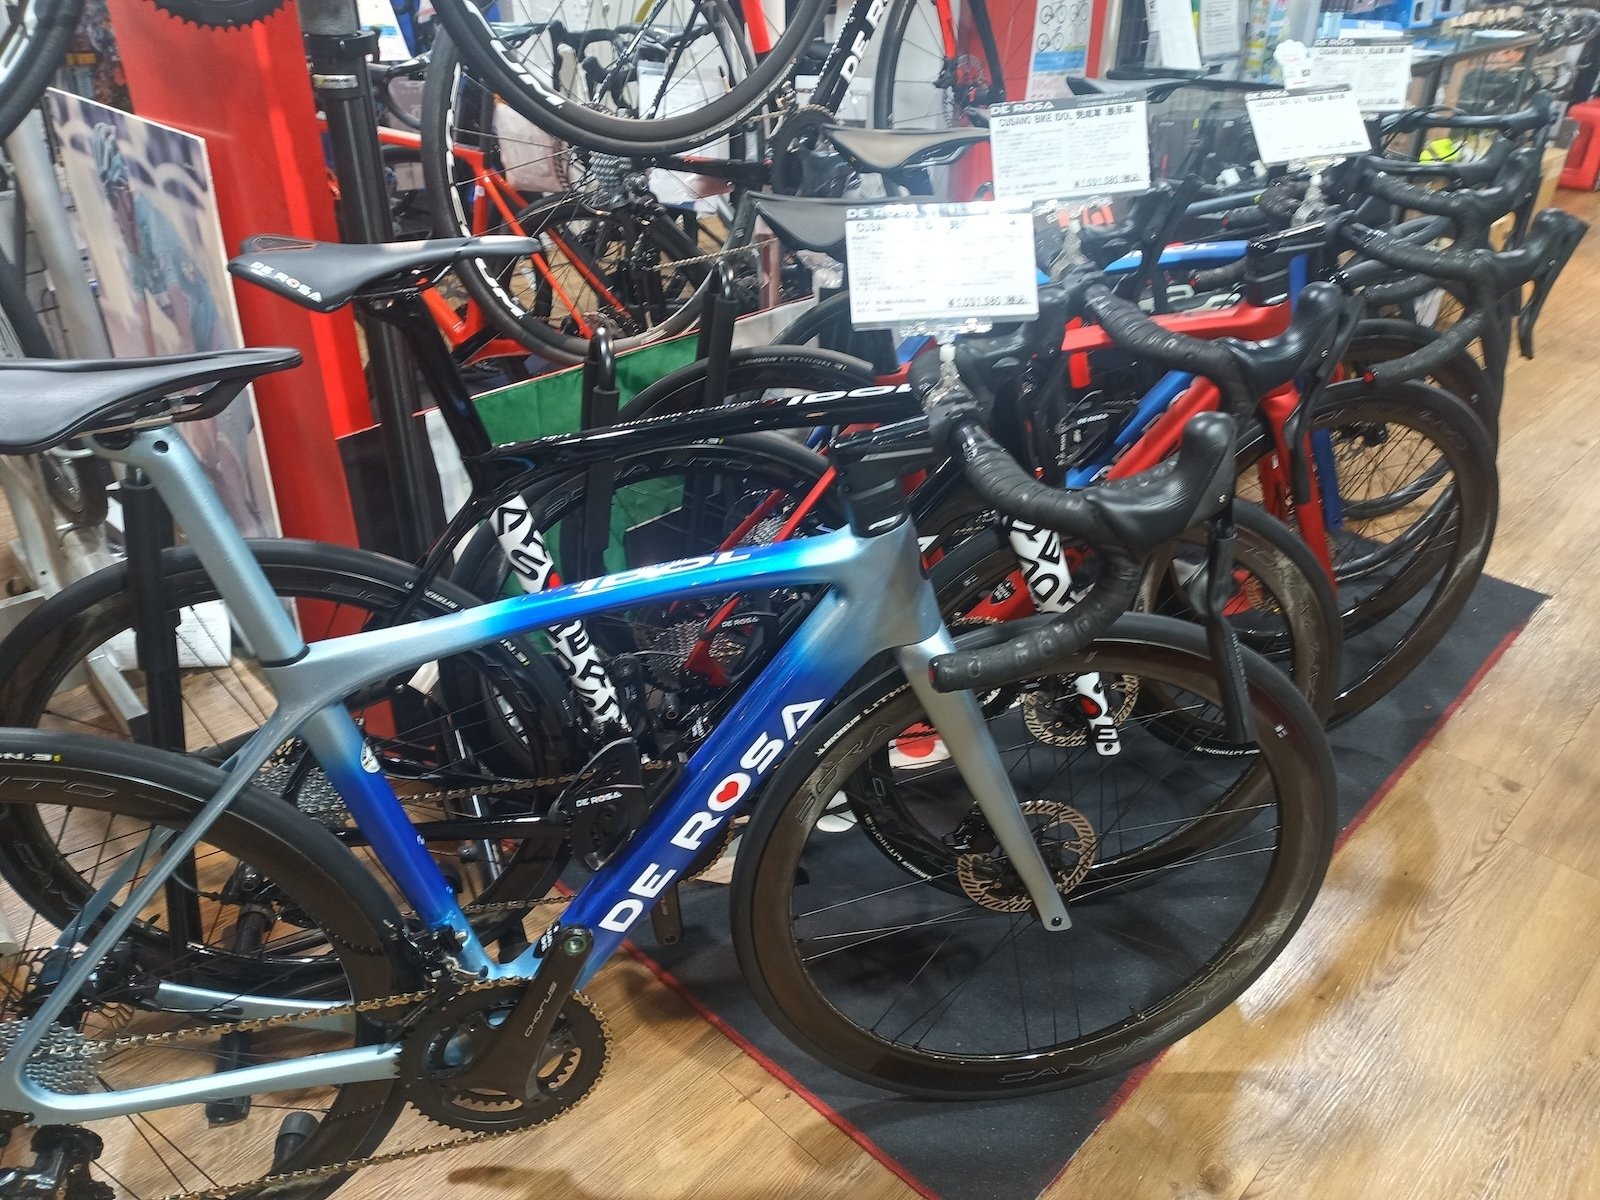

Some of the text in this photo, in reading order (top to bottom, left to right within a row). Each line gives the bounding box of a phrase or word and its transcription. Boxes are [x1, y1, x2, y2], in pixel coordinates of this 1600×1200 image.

[840, 29, 869, 84] DE
[990, 101, 1055, 115] DE ROSA
[846, 208, 870, 219] DE
[273, 271, 323, 303] ROSA
[575, 791, 623, 808] DE ROSA
[597, 697, 827, 933] DE ROSA
[524, 981, 558, 1038] CHORUS
